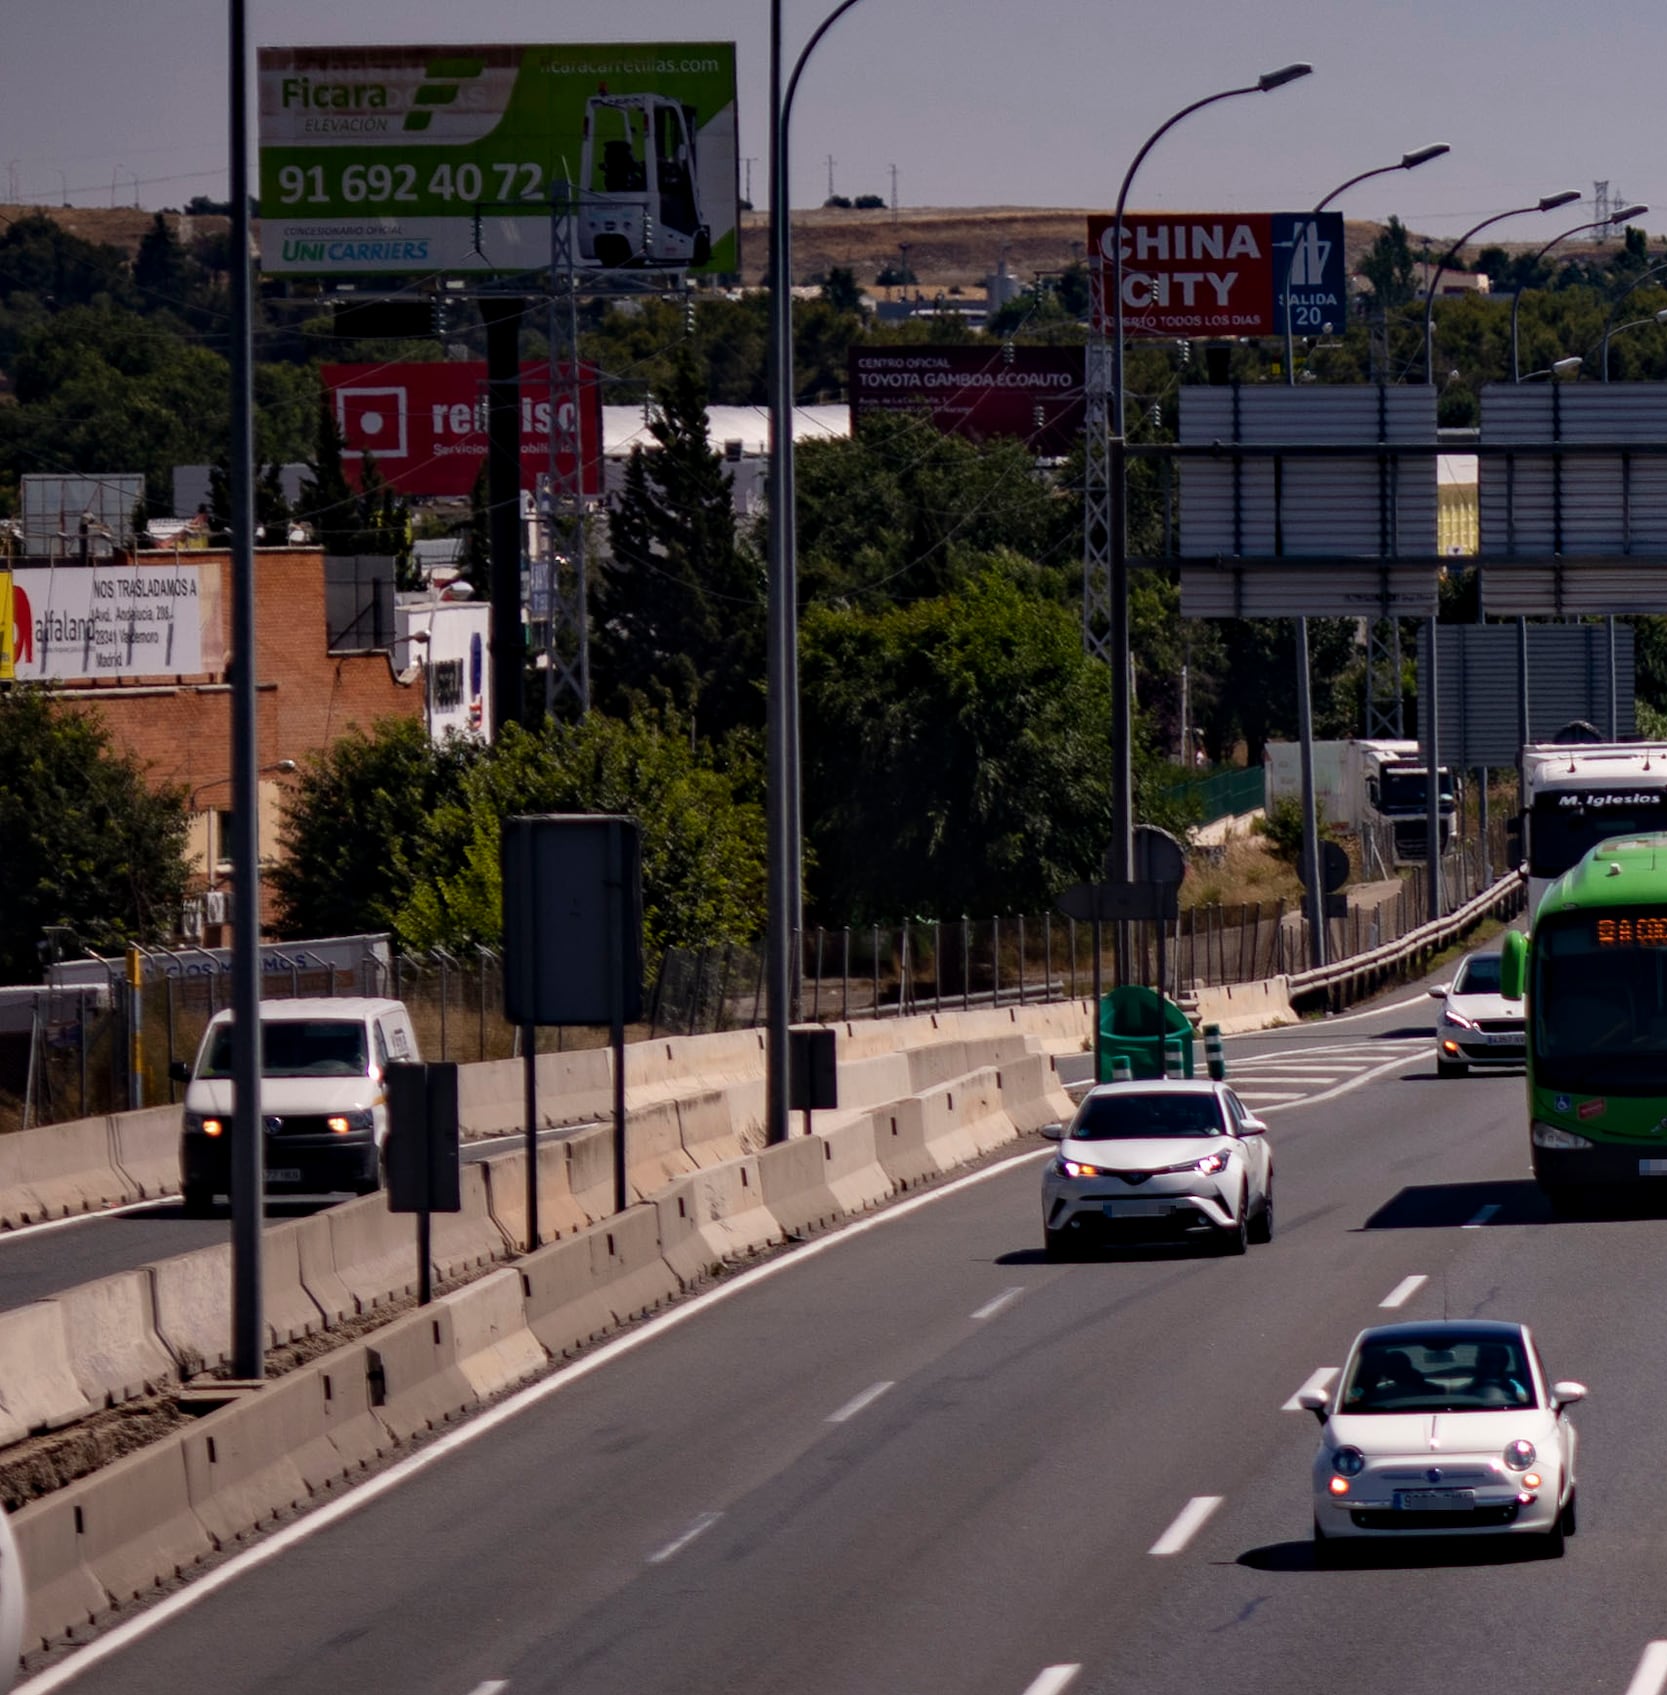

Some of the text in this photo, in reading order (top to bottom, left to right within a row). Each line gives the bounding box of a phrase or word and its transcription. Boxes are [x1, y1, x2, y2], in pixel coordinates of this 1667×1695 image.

[282, 77, 387, 107] Ficara
[278, 163, 545, 204] 91 692 40 72
[1101, 224, 1262, 308] CHINA CITY
[1278, 293, 1338, 306] SALIDA
[1160, 315, 1201, 327] TODOS
[1205, 314, 1229, 326] LOS
[1295, 307, 1321, 325] 20
[858, 358, 951, 369] CENTRO OFICIAL
[858, 372, 922, 388] TOYOTA
[923, 372, 993, 388] GAMBOA
[93, 579, 197, 598] NOS TRASLADAMOS A
[1558, 796, 1583, 806] M.
